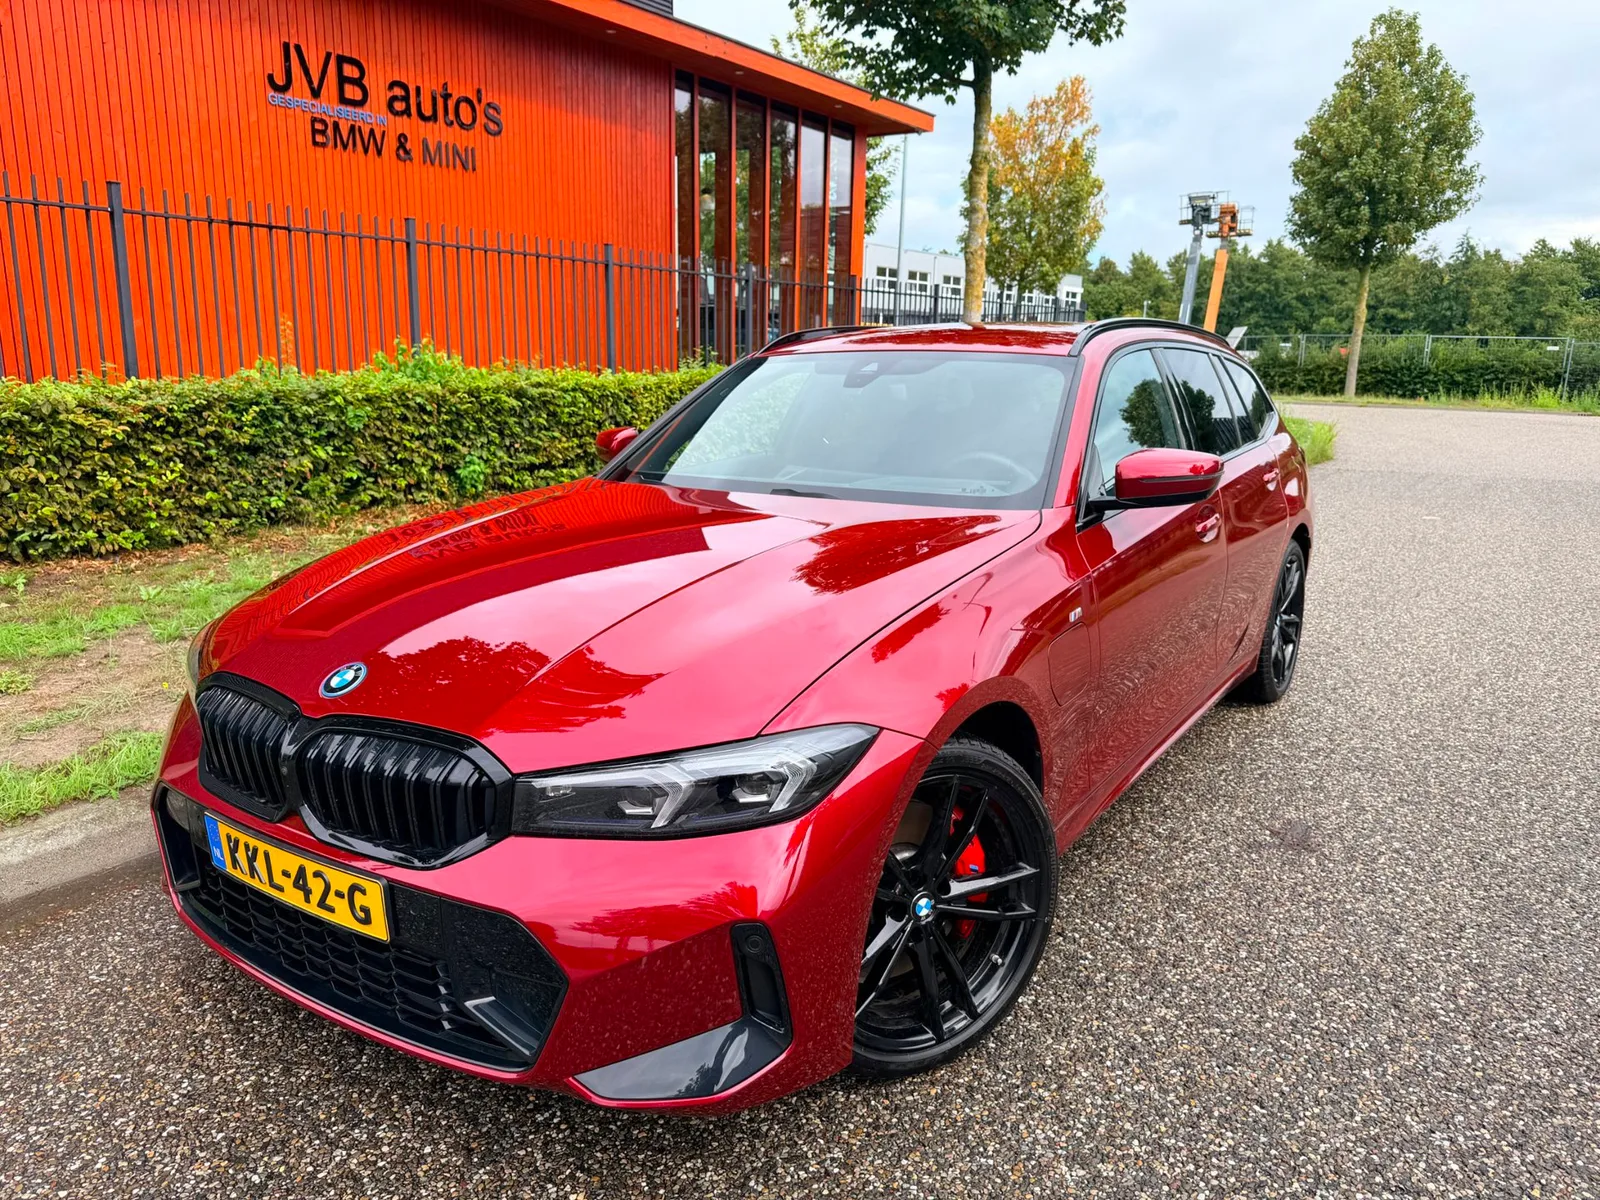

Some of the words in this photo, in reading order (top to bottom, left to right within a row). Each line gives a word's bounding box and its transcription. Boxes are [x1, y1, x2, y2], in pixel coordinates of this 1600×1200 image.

[267, 41, 369, 107] JVB
[387, 79, 503, 136] auto's
[268, 93, 374, 124] GESPECIALISEERD
[376, 115, 387, 126] IN
[310, 116, 386, 158] BMW
[395, 132, 413, 162] &
[422, 137, 477, 173] MINI
[213, 845, 224, 860] NL
[226, 832, 373, 925] KKL-42-G
